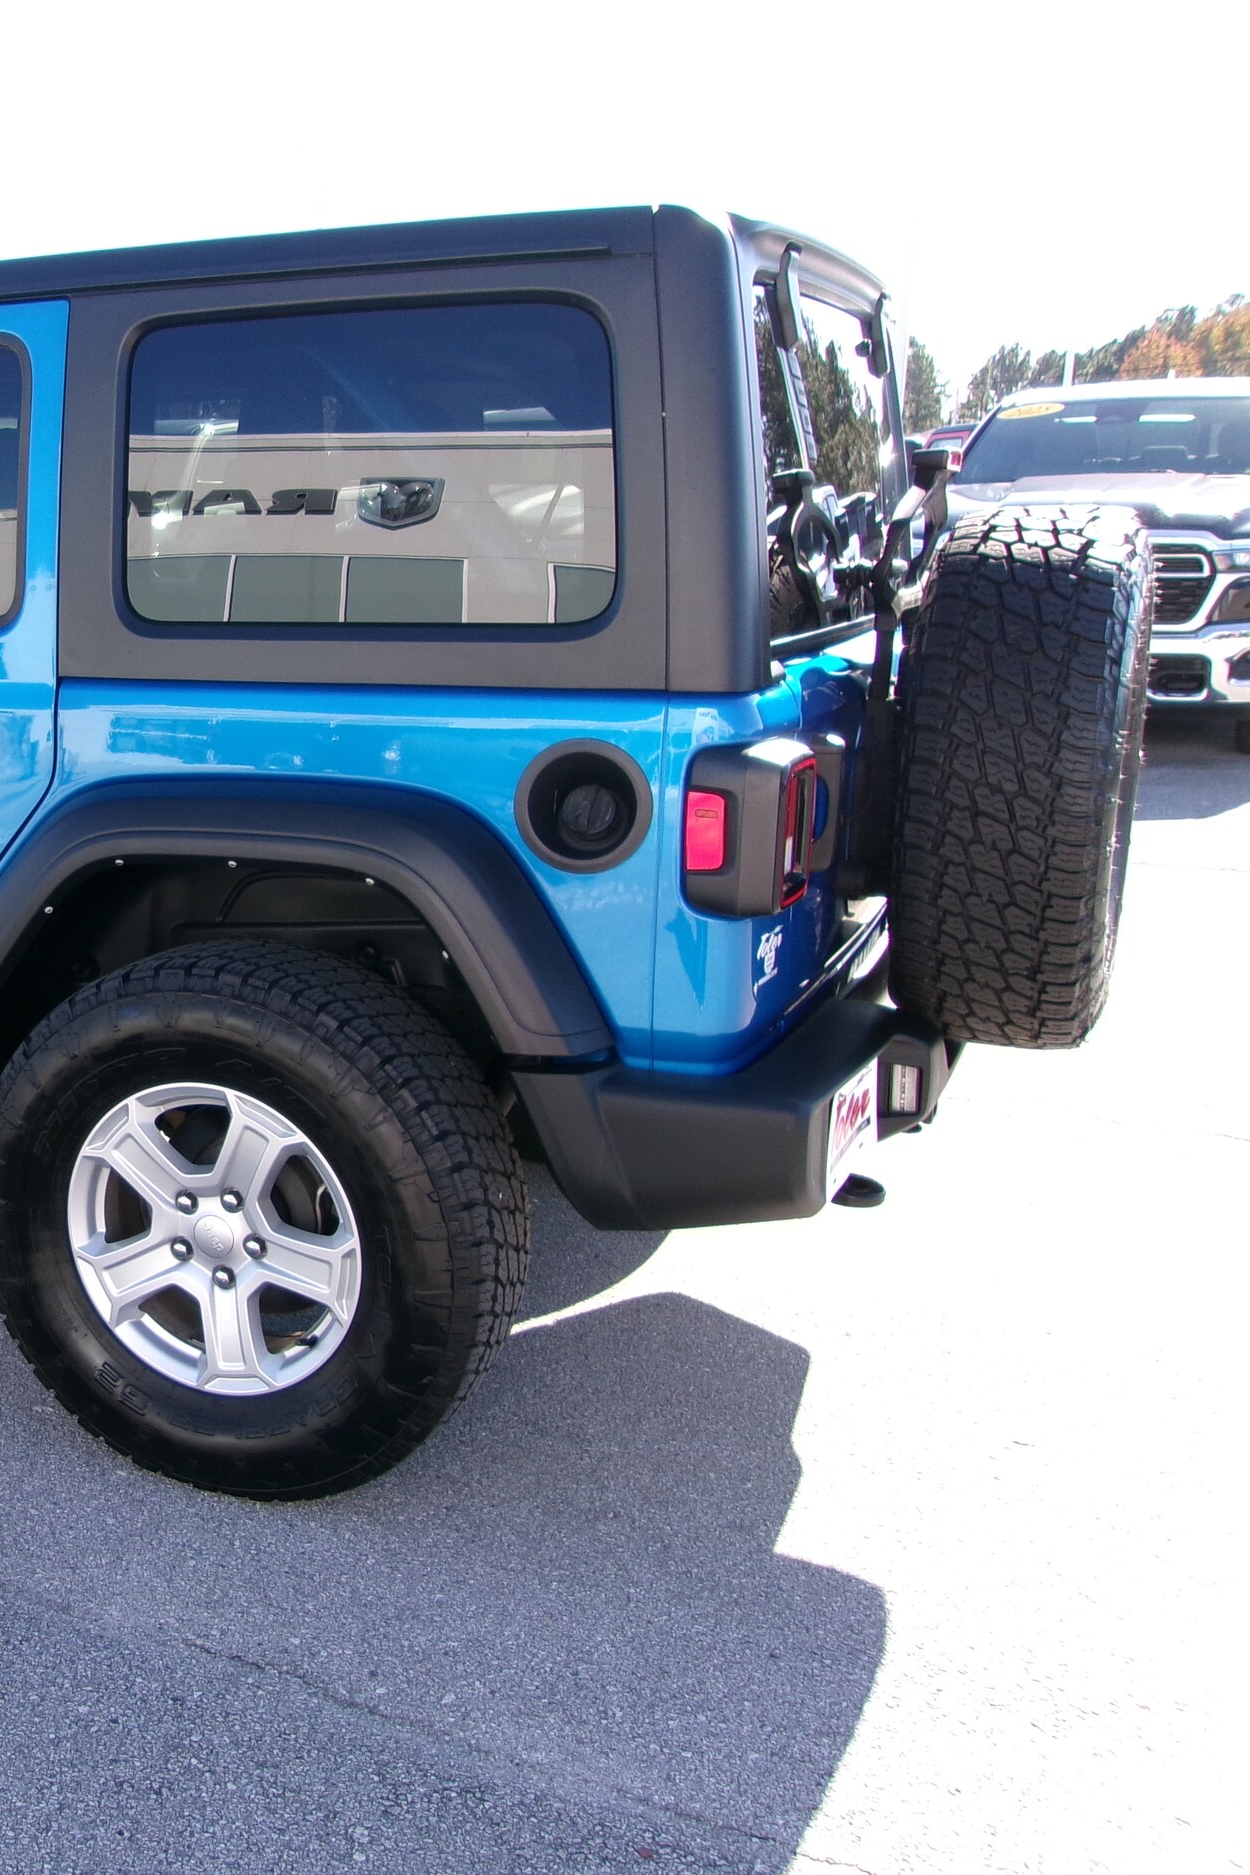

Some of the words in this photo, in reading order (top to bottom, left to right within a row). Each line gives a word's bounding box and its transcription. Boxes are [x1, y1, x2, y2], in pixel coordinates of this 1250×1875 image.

[831, 1087, 871, 1158] Toler
[202, 1222, 224, 1251] Jeep
[93, 1361, 152, 1417] G2
